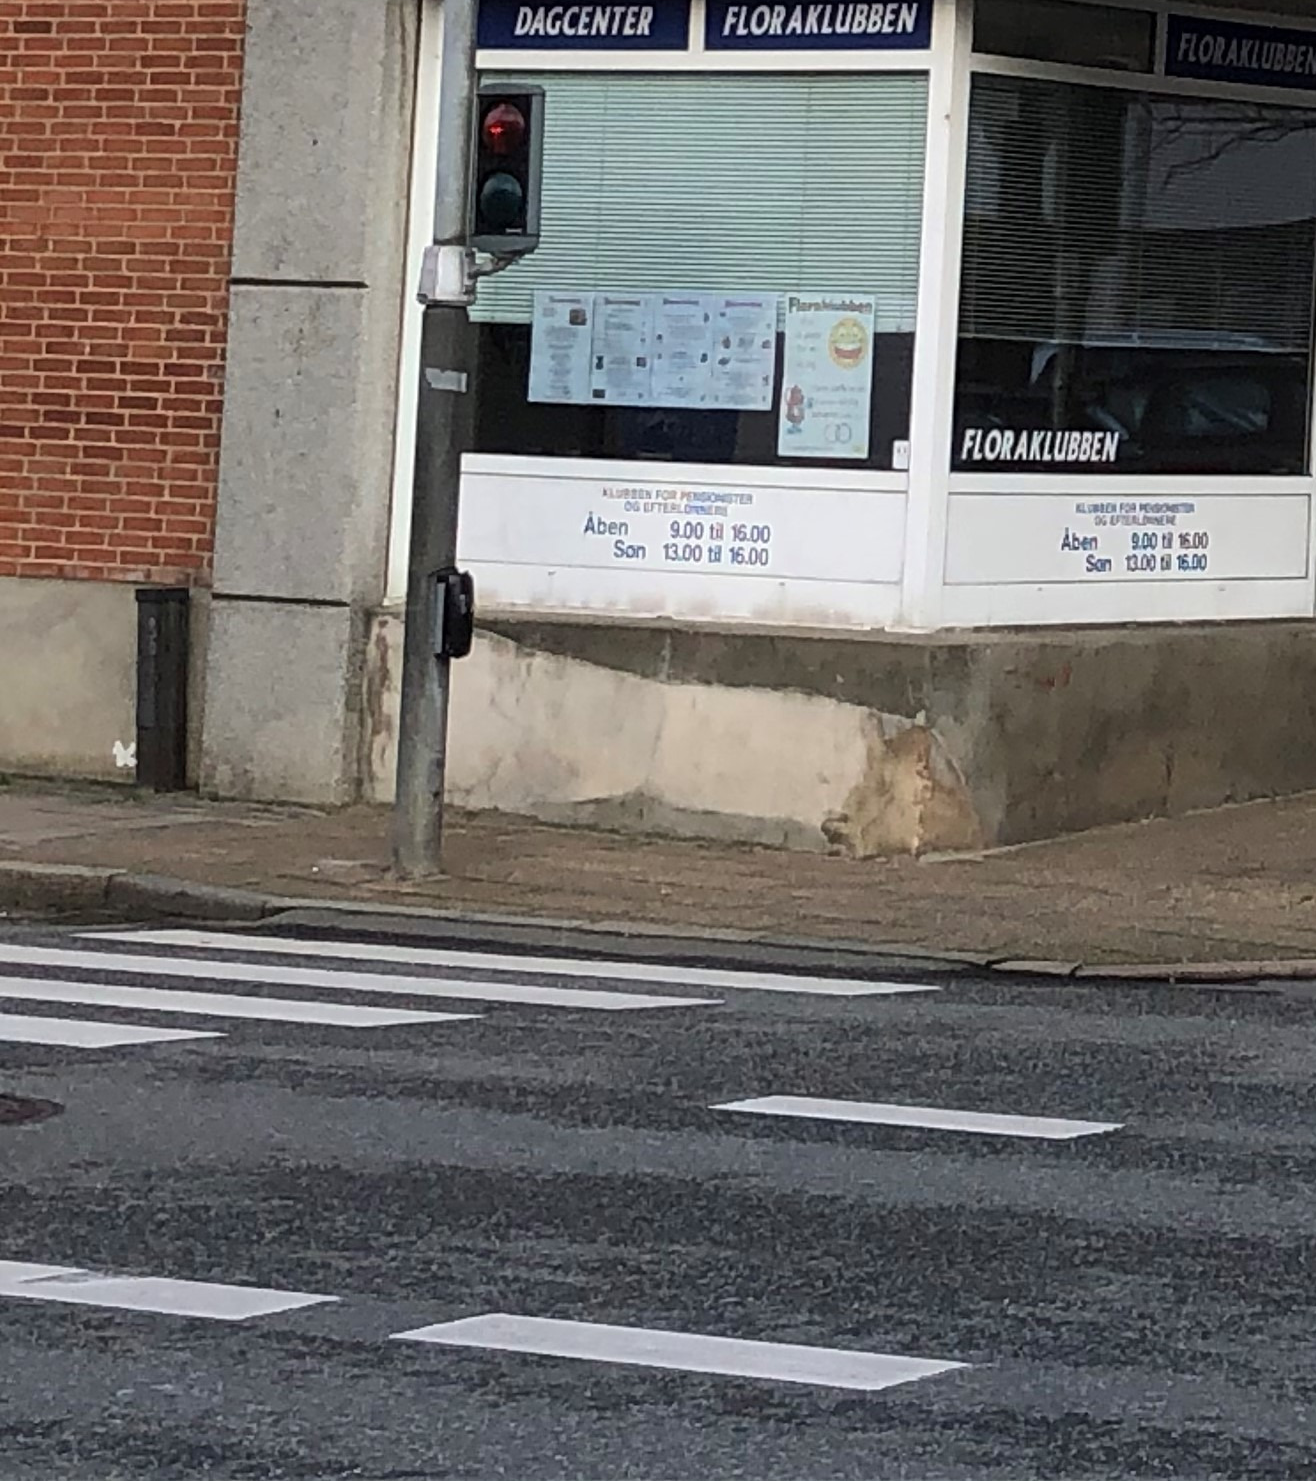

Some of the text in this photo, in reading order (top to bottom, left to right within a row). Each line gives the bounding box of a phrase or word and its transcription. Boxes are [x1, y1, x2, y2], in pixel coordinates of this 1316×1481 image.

[514, 5, 654, 36] DAGCENTER
[722, 2, 918, 37] FLORAKLUBBEN
[961, 428, 1119, 462] FLORAKLUBBEN
[602, 487, 652, 500] KLUBBEN
[655, 489, 677, 501] FOR
[624, 500, 641, 512] OG
[584, 511, 771, 543] Åben 9.00 til 16.00
[1061, 527, 1209, 550] Åben 9.00 til 16.00
[613, 539, 769, 566] Søn 13.00 til 16.00
[1085, 554, 1208, 572] Søn 13.00 til 16.00
